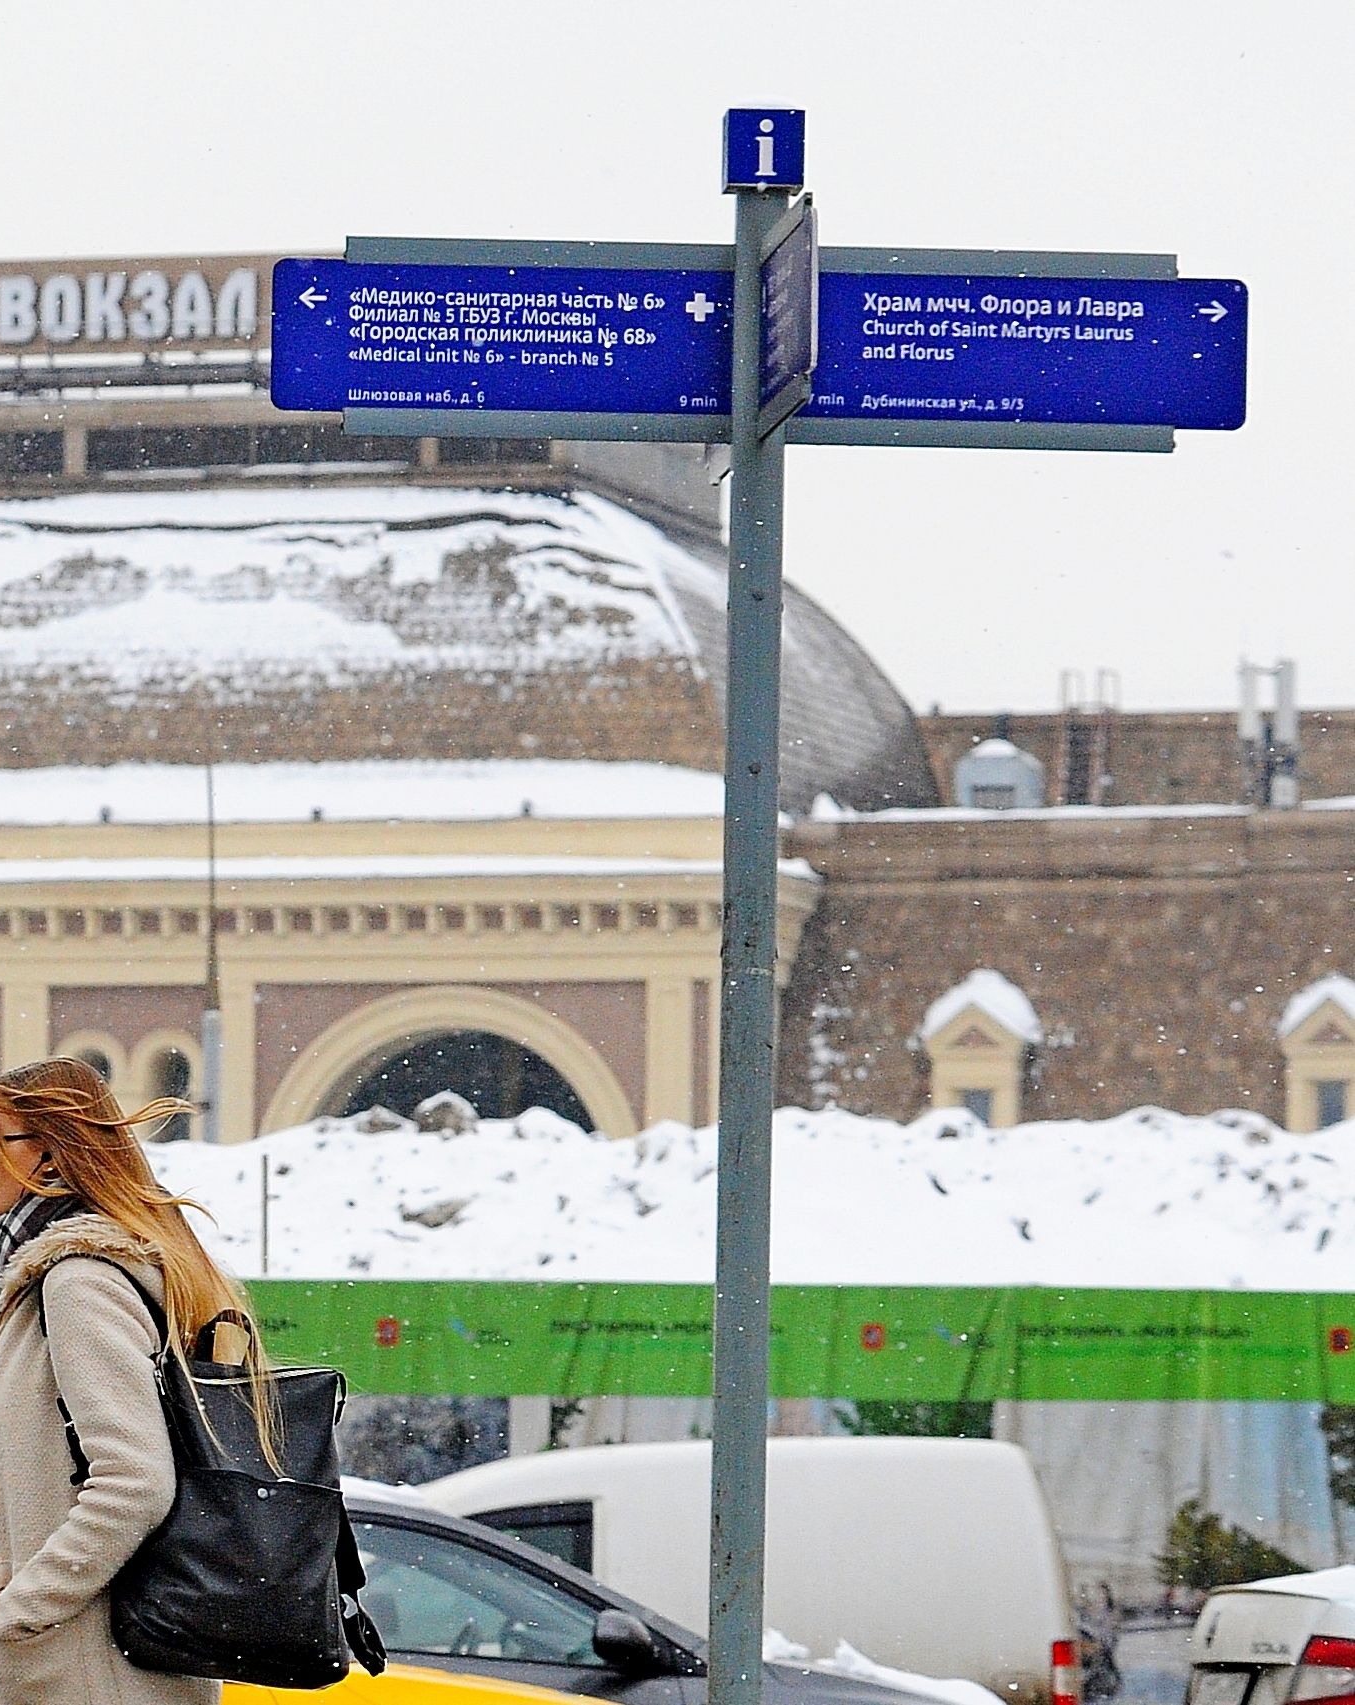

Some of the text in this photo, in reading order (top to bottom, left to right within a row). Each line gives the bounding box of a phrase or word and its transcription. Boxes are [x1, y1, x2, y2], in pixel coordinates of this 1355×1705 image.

[349, 287, 665, 311] «Медико-санитарная часть № 6»
[863, 292, 1144, 322] Храм мчч. Флора и Лавра
[348, 304, 596, 326] Филиал № 5 ГБУЗ г. Москвы
[349, 323, 656, 345] «Городская поликлиника № 68»
[862, 319, 1134, 343] Church of Saint Martyrs Laurus
[348, 347, 421, 362] «Medical
[425, 349, 459, 363] unit
[463, 349, 480, 364] №
[485, 349, 504, 364] 6»
[521, 350, 578, 366] branch
[581, 351, 599, 366] №
[604, 352, 614, 367] 5
[862, 342, 955, 361] and Florus
[348, 388, 422, 402] Шлюзовая
[477, 391, 485, 403] 6
[679, 394, 718, 407] 9 min
[818, 393, 844, 406] min
[861, 394, 956, 411] Дубининская
